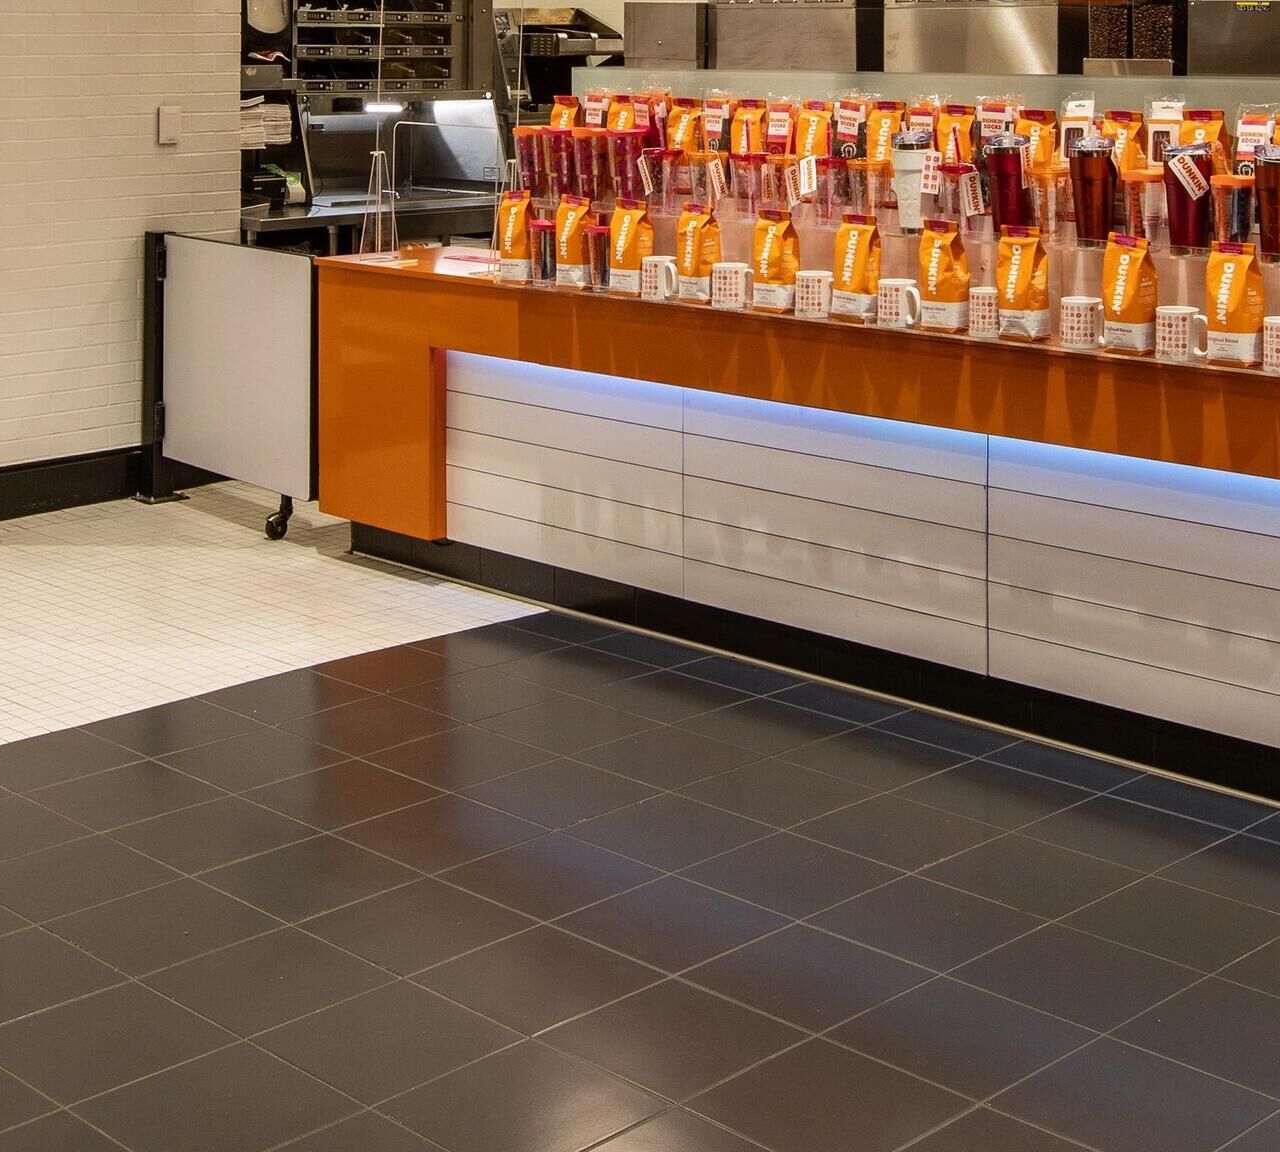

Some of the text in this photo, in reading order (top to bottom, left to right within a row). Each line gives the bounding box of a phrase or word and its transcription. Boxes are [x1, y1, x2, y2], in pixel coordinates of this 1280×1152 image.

[1240, 131, 1265, 139] DUNKIN'
[970, 176, 981, 214] DUNKIN'
[1176, 157, 1207, 194] DUNKIN'
[760, 224, 777, 279] DUNKIN'
[842, 230, 859, 286] DUNKIN'
[928, 240, 943, 296] DUNKIN'
[1006, 244, 1023, 304] DUNKIN'
[1112, 254, 1131, 315] DUNKIN'
[1216, 262, 1235, 326] DUNKIN'
